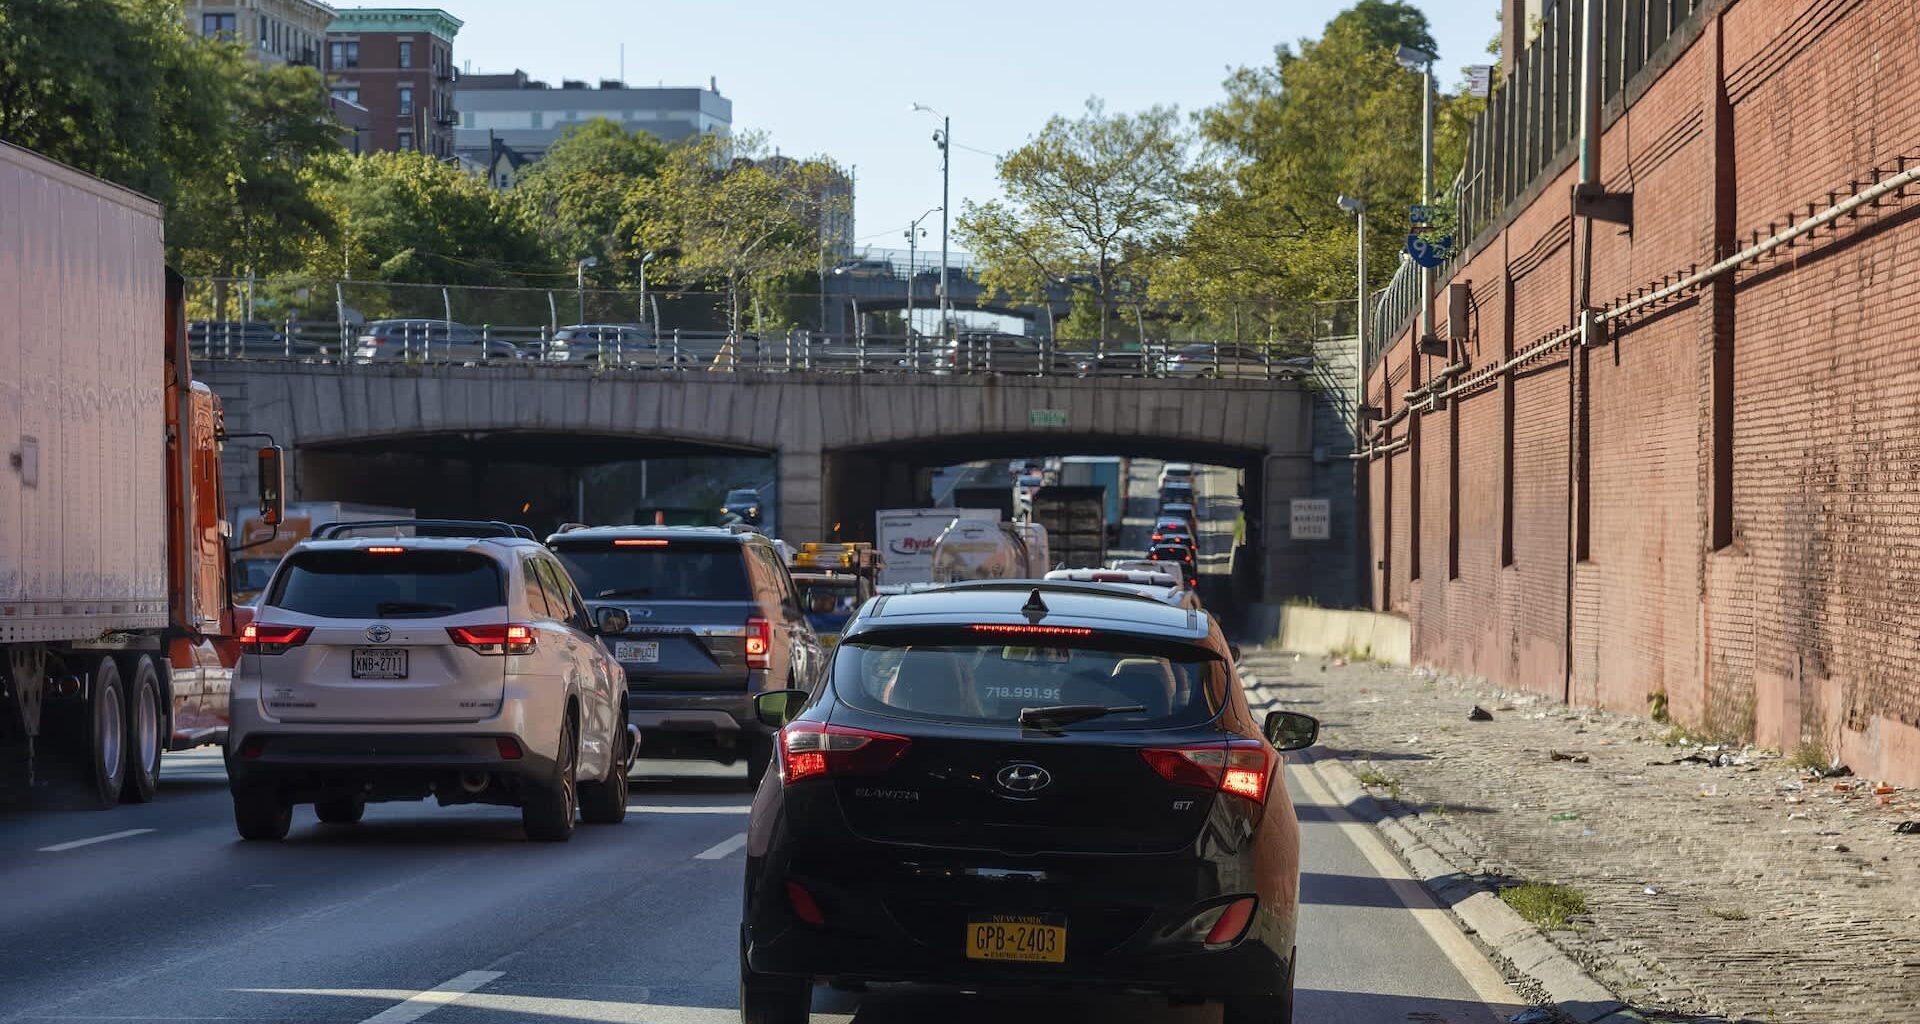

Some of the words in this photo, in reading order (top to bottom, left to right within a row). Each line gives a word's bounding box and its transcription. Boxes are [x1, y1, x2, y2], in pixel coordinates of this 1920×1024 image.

[1173, 800, 1194, 810] GT
[992, 914, 1015, 922] NEW
[1017, 914, 1041, 924] YORK
[1017, 927, 1056, 952] 2403
